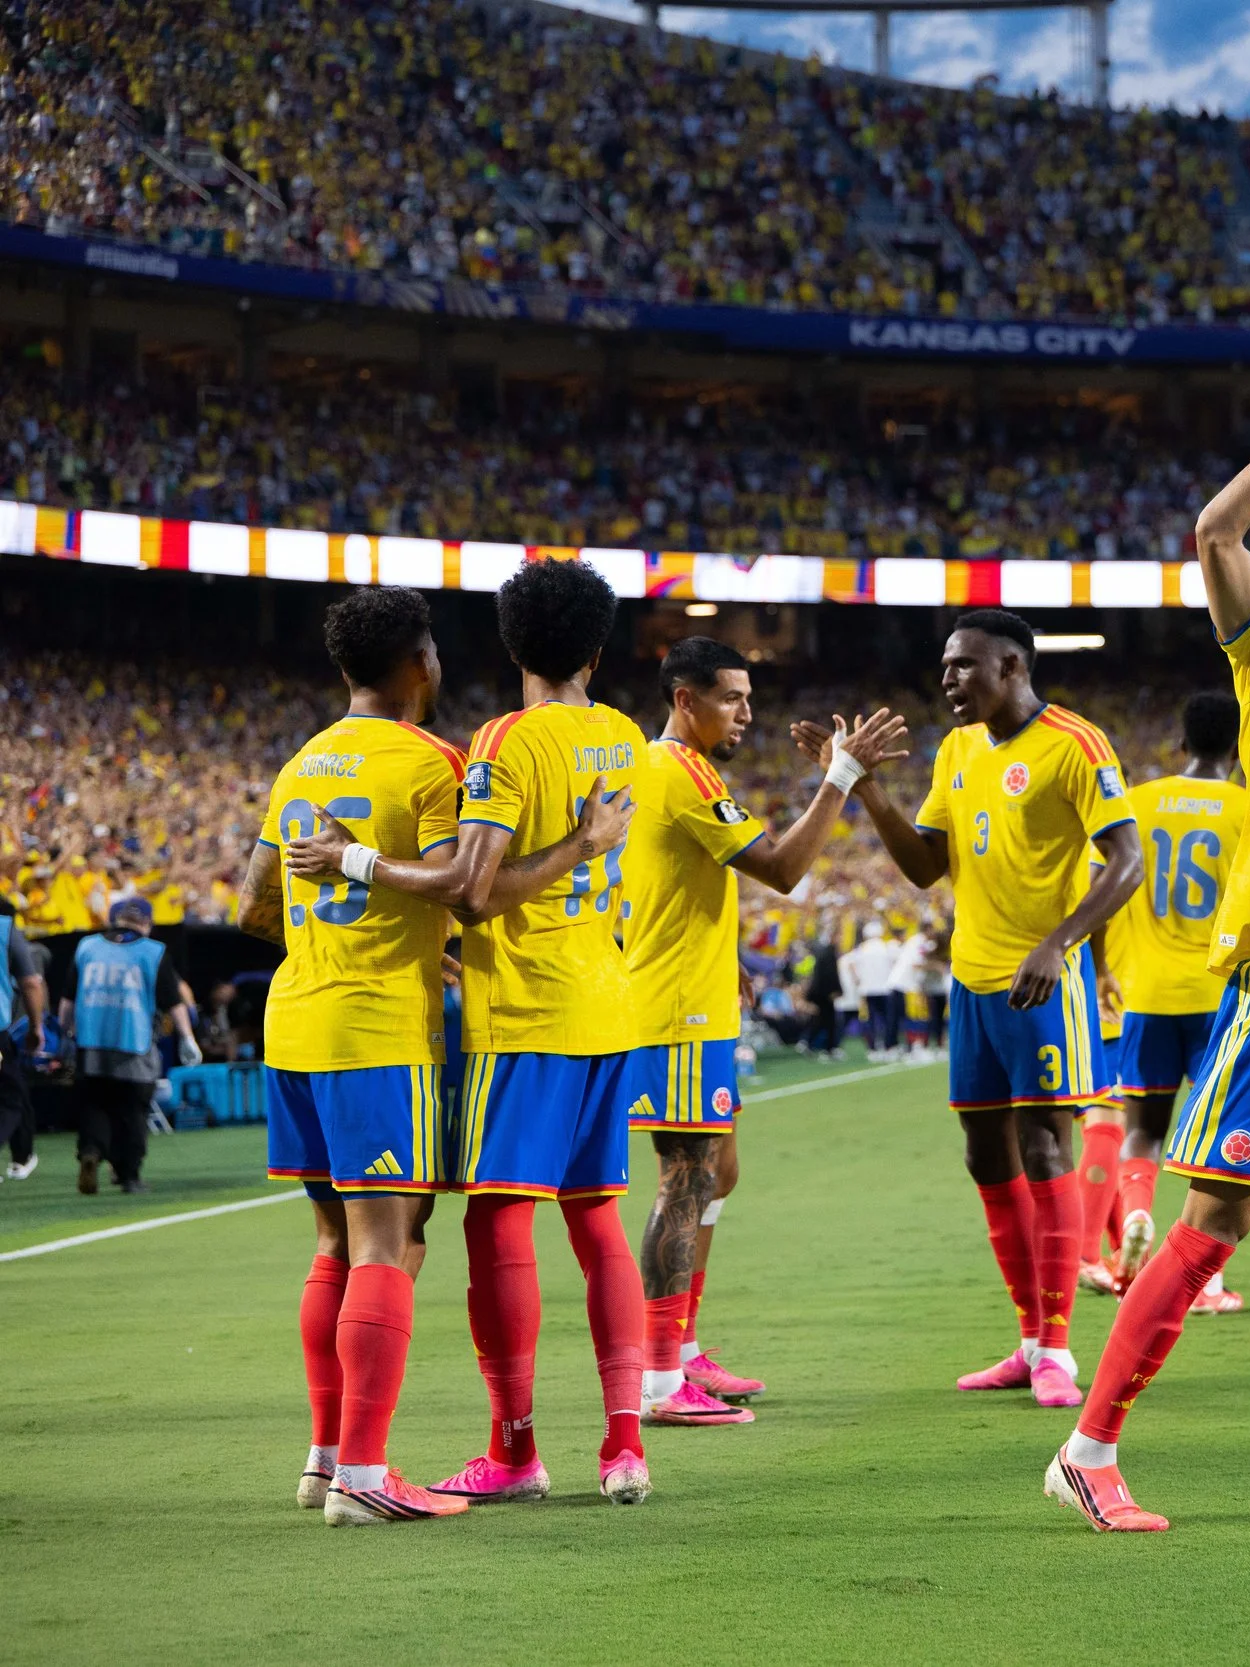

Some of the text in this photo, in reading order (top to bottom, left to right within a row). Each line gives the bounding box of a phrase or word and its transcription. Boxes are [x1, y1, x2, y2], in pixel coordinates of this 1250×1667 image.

[850, 320, 1136, 355] KANSAS CITY
[973, 811, 990, 855] 3
[1151, 828, 1221, 920] 16
[1037, 1044, 1063, 1091] 3
